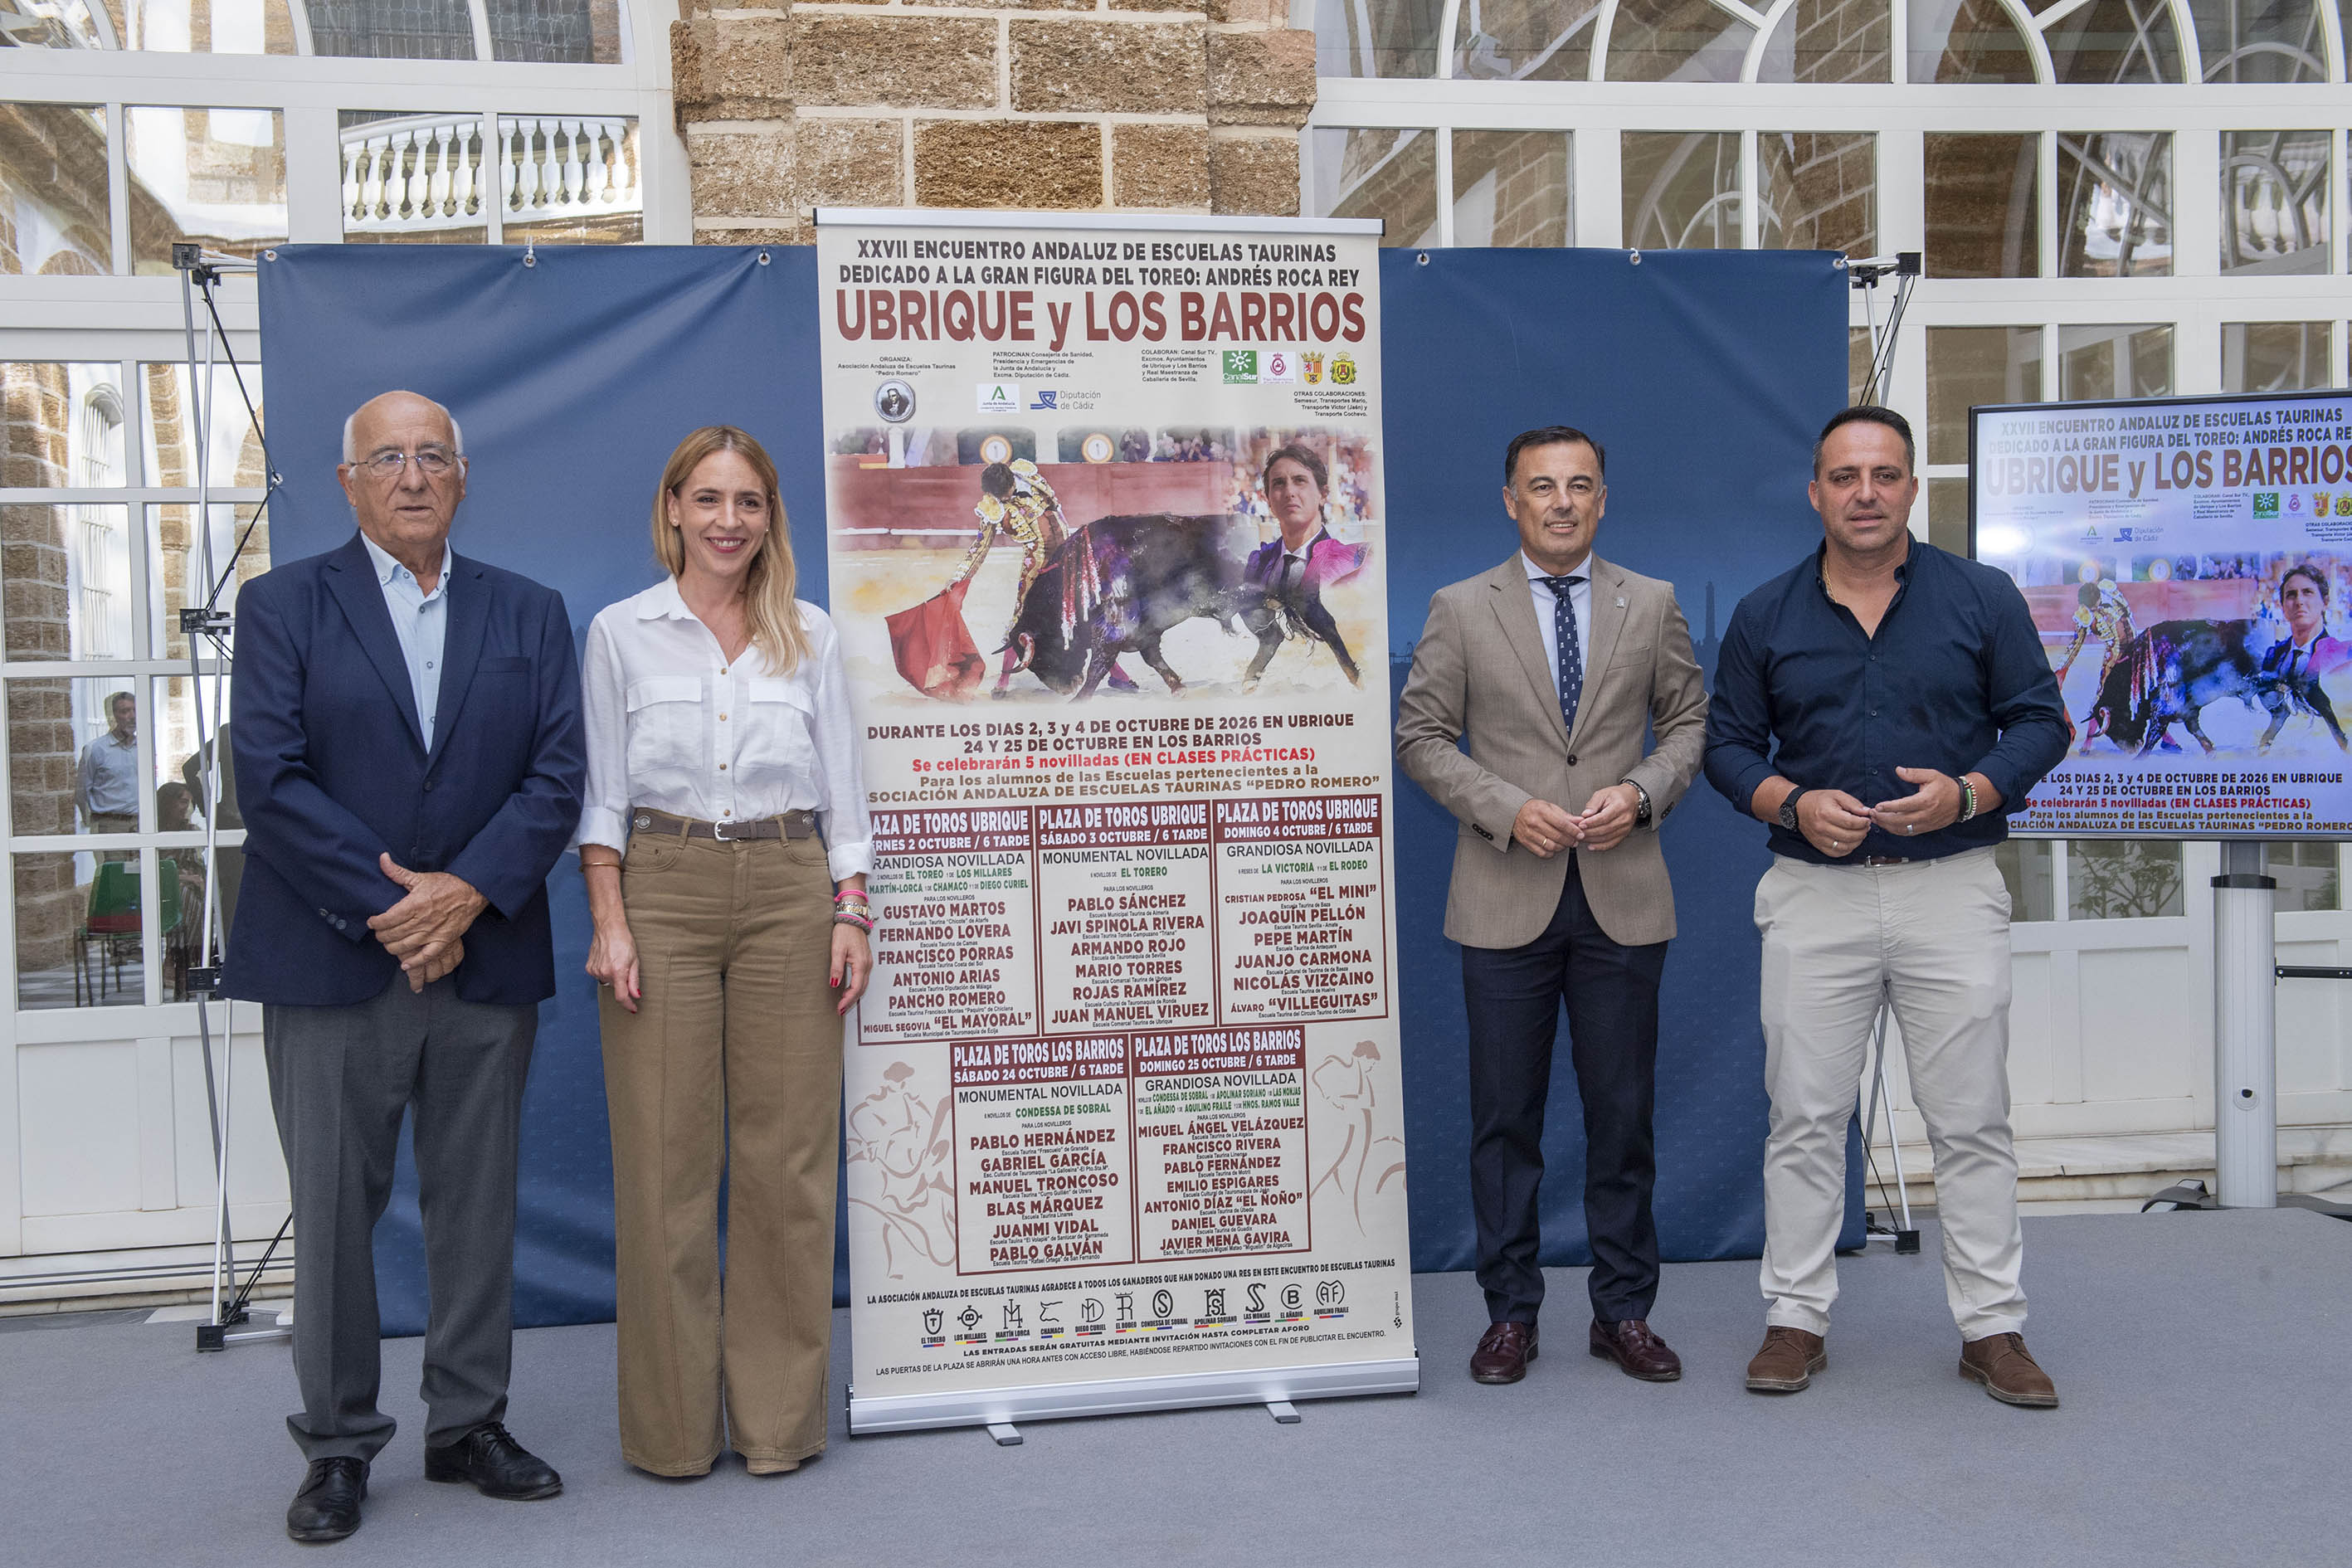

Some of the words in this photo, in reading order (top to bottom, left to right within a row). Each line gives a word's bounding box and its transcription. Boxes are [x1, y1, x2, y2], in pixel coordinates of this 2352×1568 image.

[858, 240, 907, 259] XXVII
[914, 241, 1025, 260] ENCUENTRO
[1032, 241, 1117, 261] ANDALUZ
[1123, 242, 1145, 261] DE
[1152, 243, 1242, 261] ESCUELAS
[1248, 244, 1336, 262] TAURINAS
[840, 265, 929, 284] DEDICADO
[936, 265, 947, 284] A
[953, 265, 975, 285] LA
[981, 266, 1028, 285] GRAN
[1035, 266, 1097, 285] FIGURA
[1103, 267, 1133, 285] DEL
[1139, 267, 1200, 286] TOREO:
[1205, 264, 1272, 286] ANDRÉS
[1278, 268, 1322, 287] ROCA
[1328, 269, 1359, 287] REY
[836, 290, 1035, 341] UBRIQUE
[1047, 302, 1072, 352] y
[1085, 291, 1166, 342] LOS
[1181, 291, 1365, 342] BARRIOS
[1060, 390, 1102, 400] Diputación
[1073, 401, 1094, 410] Cádiz
[2001, 421, 2034, 436] XXVII
[2038, 418, 2115, 434] ENCUENTRO
[2119, 415, 2179, 431] ANDALUZ
[2184, 414, 2200, 428] DE
[2204, 411, 2272, 427] ESCUELAS
[2276, 407, 2343, 424] TAURINAS
[1985, 454, 2119, 496] UBRIQUE
[2128, 460, 2145, 499] y
[2155, 450, 2213, 489] LOS
[868, 724, 944, 739] DURANTE
[951, 723, 980, 738] LOS
[986, 722, 1023, 736] DIAS
[1029, 722, 1041, 738] 2,
[1047, 721, 1055, 735] 3
[1061, 723, 1069, 737] y
[1075, 720, 1084, 733] 4
[1090, 720, 1110, 733] DE
[1116, 718, 1189, 733] OCTUBRE
[1194, 717, 1213, 731] DE
[1219, 716, 1257, 730] 2026
[1263, 715, 1283, 728] EN
[1288, 713, 1353, 728] UBRIQUE
[964, 740, 982, 754] 24
[988, 739, 998, 753] Y
[1004, 739, 1021, 752] 25
[1028, 738, 1047, 752] DE
[1053, 736, 1127, 751] OCTUBRE
[1132, 735, 1152, 749] EN
[1158, 734, 1187, 748] LOS
[1192, 733, 1261, 748] BARRIOS
[913, 758, 931, 772] Se
[937, 756, 1020, 772] celebrarán
[1025, 755, 1034, 769] 5
[1040, 753, 1118, 768] novilladas
[1124, 752, 1151, 767] (EN
[1157, 750, 1215, 765] CLASES
[1221, 747, 1314, 762] PRÁCTICAS)
[2060, 785, 2072, 796] 24
[2077, 785, 2082, 796] Y
[2087, 785, 2099, 796] 25
[2103, 785, 2116, 796] DE
[2121, 785, 2173, 796] OCTUBRE
[2177, 785, 2191, 796] EN
[2195, 785, 2216, 796] LOS
[2220, 785, 2270, 797] BARRIOS
[2025, 797, 2038, 807] Se
[2041, 797, 2096, 808] celebrarán
[2101, 797, 2106, 808] 5
[2111, 797, 2166, 808] novilladas
[2170, 798, 2189, 810] (EN
[2194, 798, 2237, 808] CLASES
[2241, 796, 2310, 810] PRÁCTICAS)
[1040, 809, 1082, 830] PLAZA
[1085, 807, 1102, 828] DE
[1105, 806, 1147, 827] TOROS
[1152, 804, 1205, 825] UBRIQUE
[1040, 830, 1086, 845] SÁBADO
[1089, 831, 1096, 844] 3
[1099, 830, 1151, 843] OCTUBRE
[1162, 829, 1169, 841] 6
[1172, 828, 1206, 840] TARDE
[1043, 850, 1132, 864] MONUMENTAL
[1137, 846, 1208, 860] NOVILLADA
[1121, 868, 1131, 878] EL
[1133, 866, 1166, 877] TORERO
[1262, 864, 1273, 874] LA
[1275, 862, 1314, 873] VICTORIA
[1068, 897, 1113, 912] PABLO
[1119, 894, 1186, 910] SÁNCHEZ
[879, 926, 952, 942] FERNANDO
[958, 923, 1010, 939] LOVERA
[1254, 932, 1292, 946] PEPE
[1297, 928, 1351, 944] MARTÍN
[1052, 1009, 1088, 1024] JUAN
[1093, 1006, 1152, 1023] MANUEL
[1157, 1002, 1208, 1018] VIRUEZ
[864, 1024, 894, 1033] MIGUEL
[896, 1022, 931, 1031] SEGOVIA
[954, 1045, 991, 1067] PLAZA
[994, 1044, 1009, 1065] DE
[1011, 1042, 1049, 1064] TOROS
[1052, 1040, 1072, 1062] LOS
[1075, 1038, 1123, 1060] BARRIOS
[1140, 1059, 1185, 1073] DOMINGO
[1188, 1058, 1199, 1070] 25
[1201, 1055, 1245, 1069] OCTUBRE
[1256, 1054, 1261, 1067] 6
[1264, 1054, 1295, 1066] TARDE
[970, 1179, 1032, 1195] MANUEL
[1037, 1173, 1118, 1191] TRONCOSO
[1144, 1200, 1200, 1214] ANTONIO
[1205, 1195, 1233, 1210] DÍAZ
[982, 1346, 1026, 1356] ENTRADAS
[1030, 1342, 1056, 1351] SERÁN
[1059, 1340, 1105, 1349] GRATUITAS
[1108, 1337, 1149, 1346] MEDIANTE
[1152, 1332, 1199, 1342] INVITACIÓN
[1231, 1327, 1278, 1337] COMPLETAR
